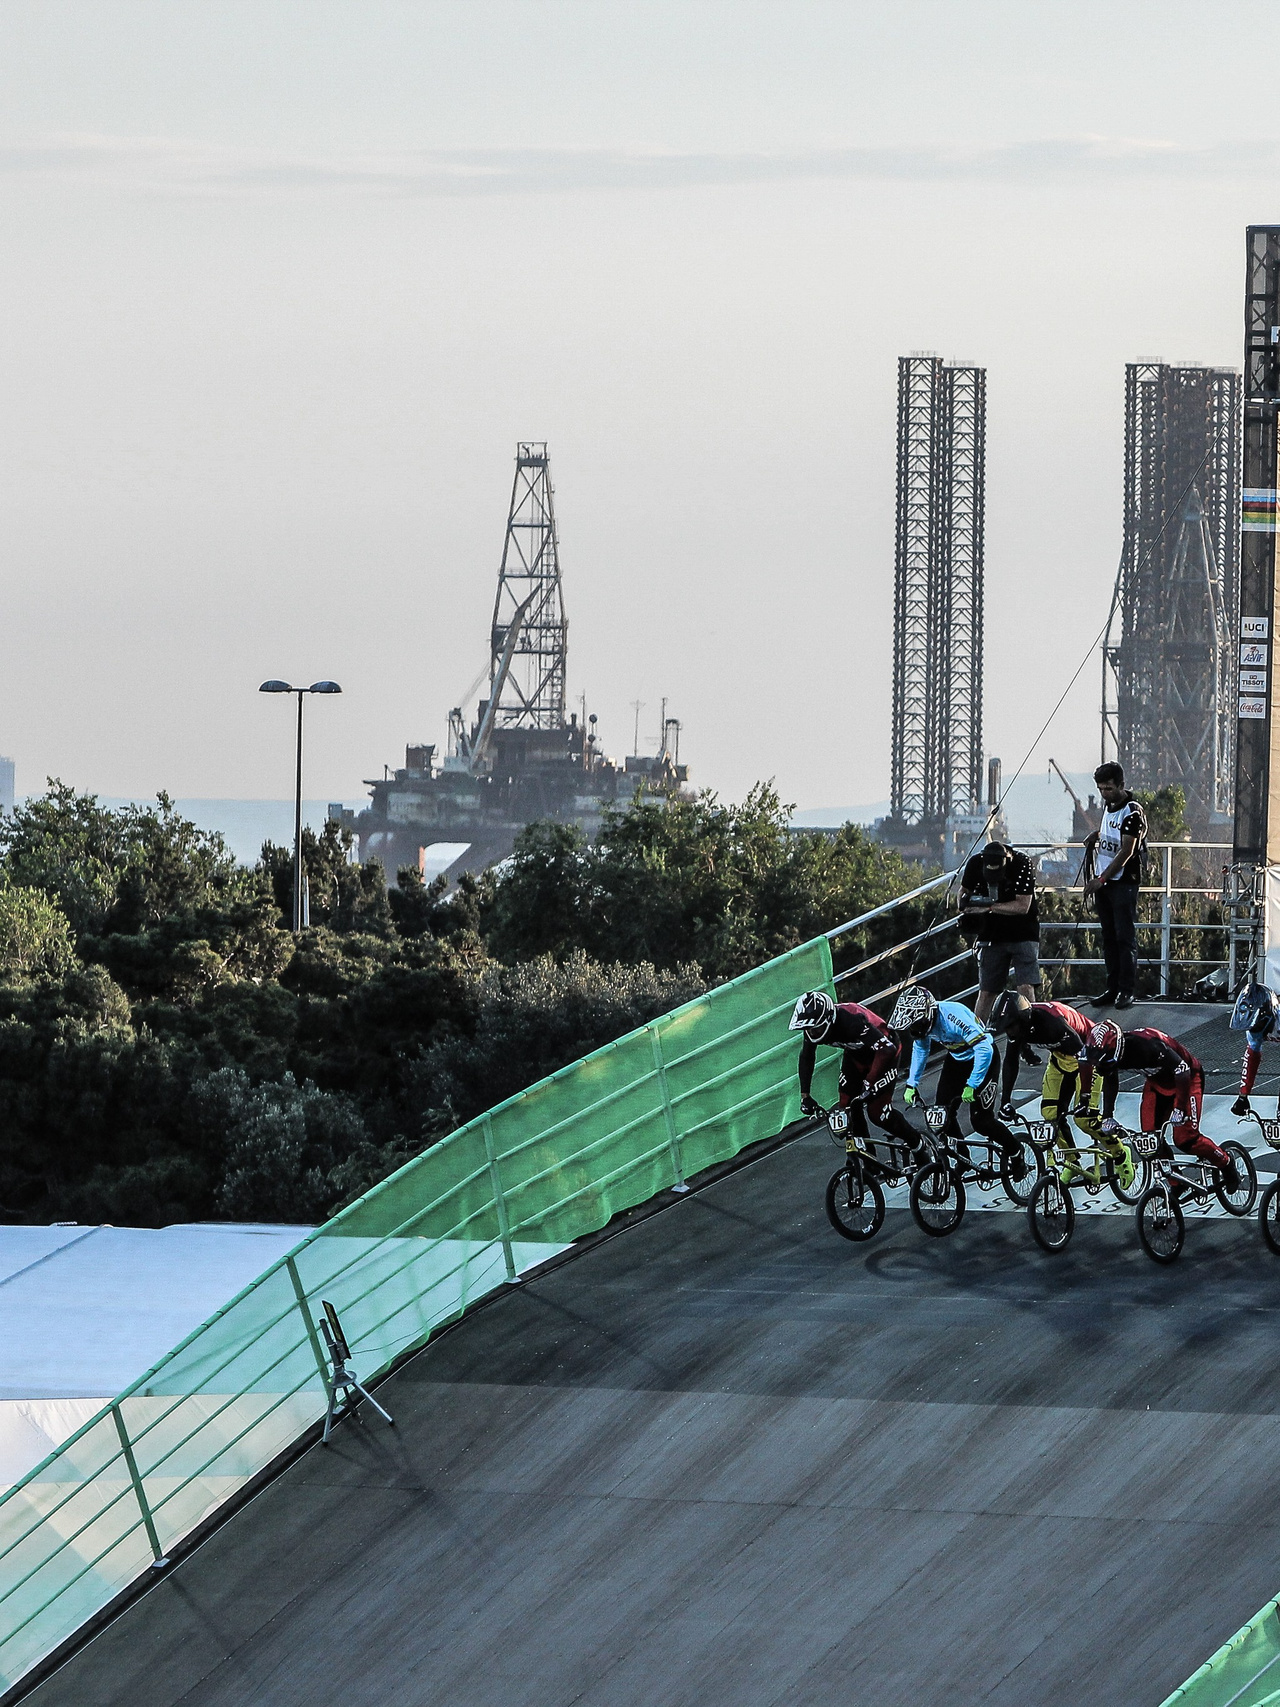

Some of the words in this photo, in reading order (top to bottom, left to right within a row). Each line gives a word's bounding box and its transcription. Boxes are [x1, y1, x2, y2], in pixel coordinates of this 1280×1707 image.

[1248, 624, 1264, 632] UCI
[831, 1115, 843, 1129] 76
[927, 1111, 943, 1124] 278
[1032, 1128, 1051, 1140] 127
[1136, 1137, 1157, 1151] 996
